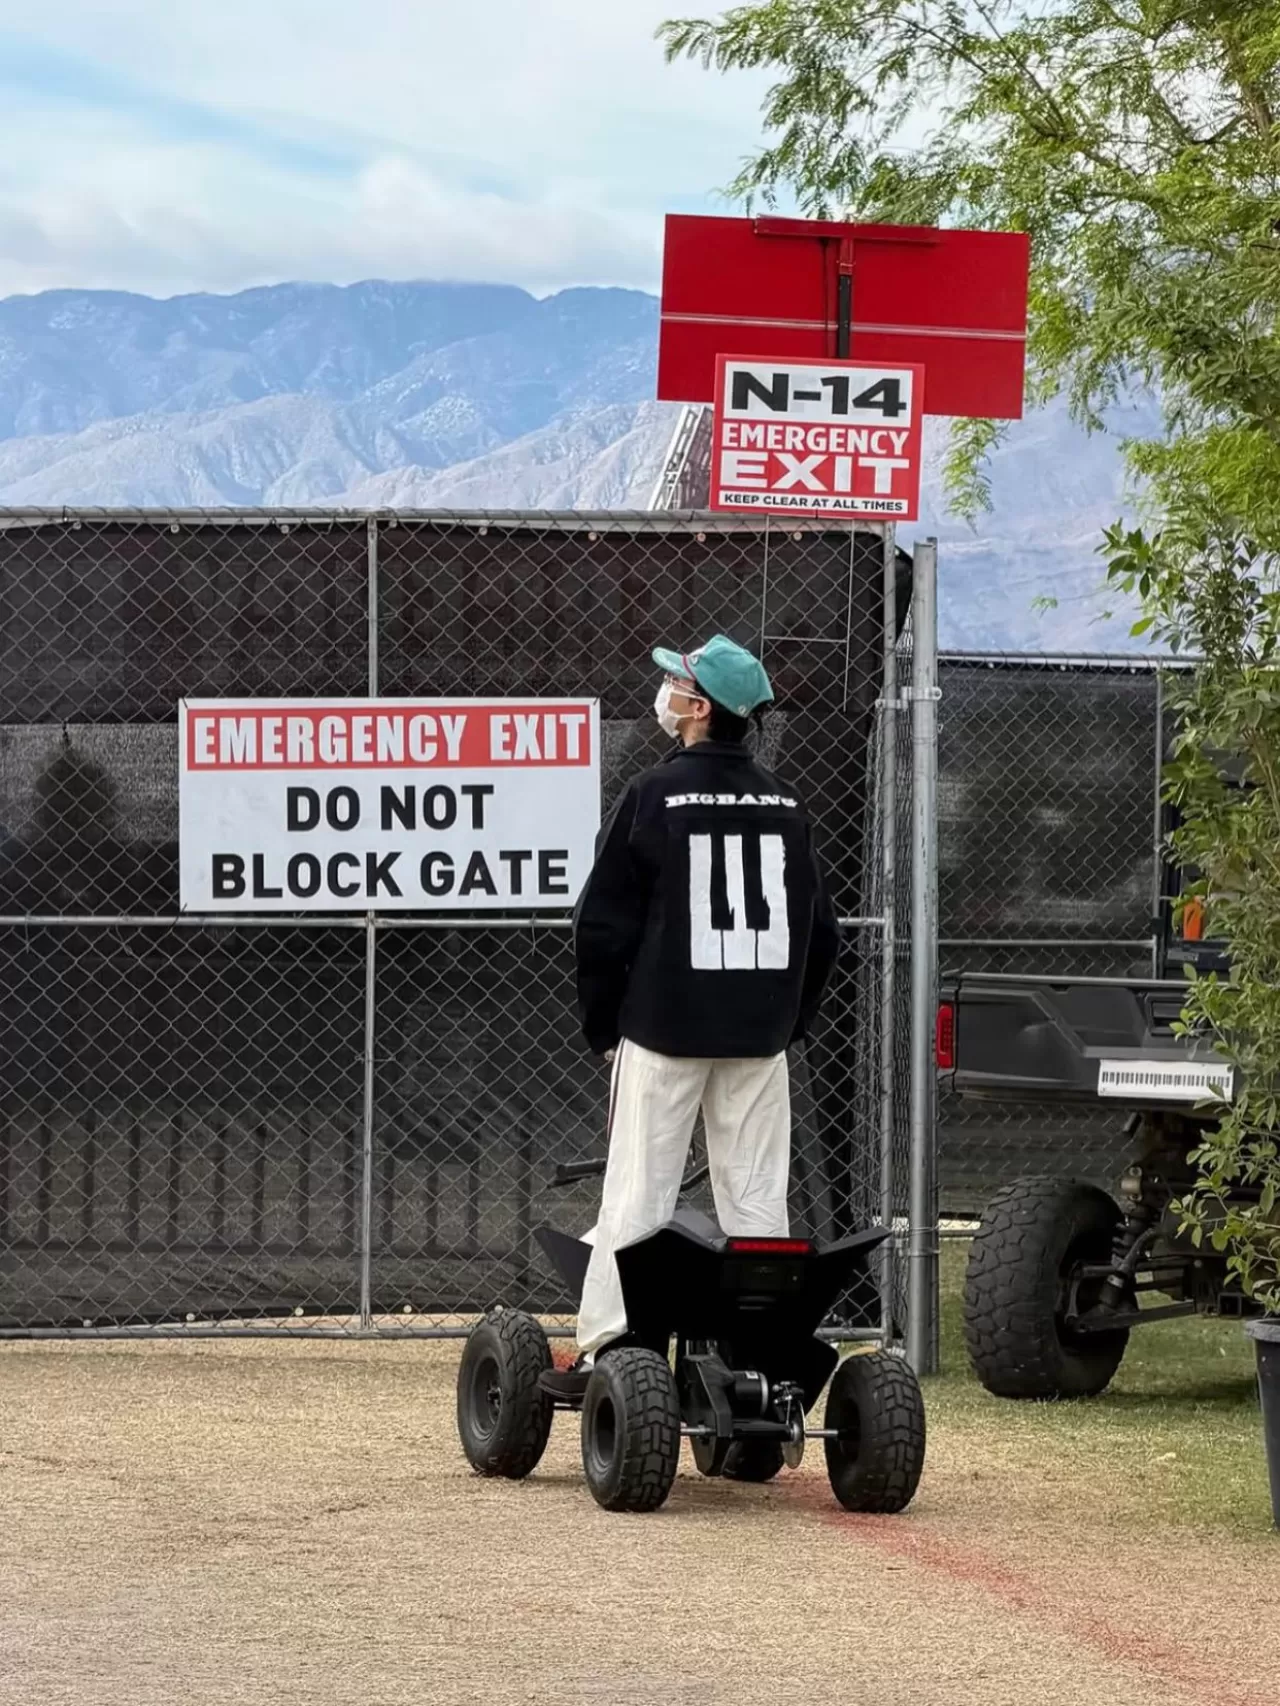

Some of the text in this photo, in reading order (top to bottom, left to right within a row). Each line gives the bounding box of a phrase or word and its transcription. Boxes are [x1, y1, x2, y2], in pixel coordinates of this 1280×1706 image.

[732, 371, 907, 417] N-14
[721, 422, 910, 455] EMERGENCY
[720, 450, 910, 494] EXIT
[724, 493, 903, 511] KEEP CLEAR AT ALL TIMES
[194, 713, 586, 764] EMERGENCY EXIT
[286, 784, 494, 832] DO NOT
[664, 793, 798, 808] BIGBANG
[212, 850, 569, 899] BLOCK GATE
